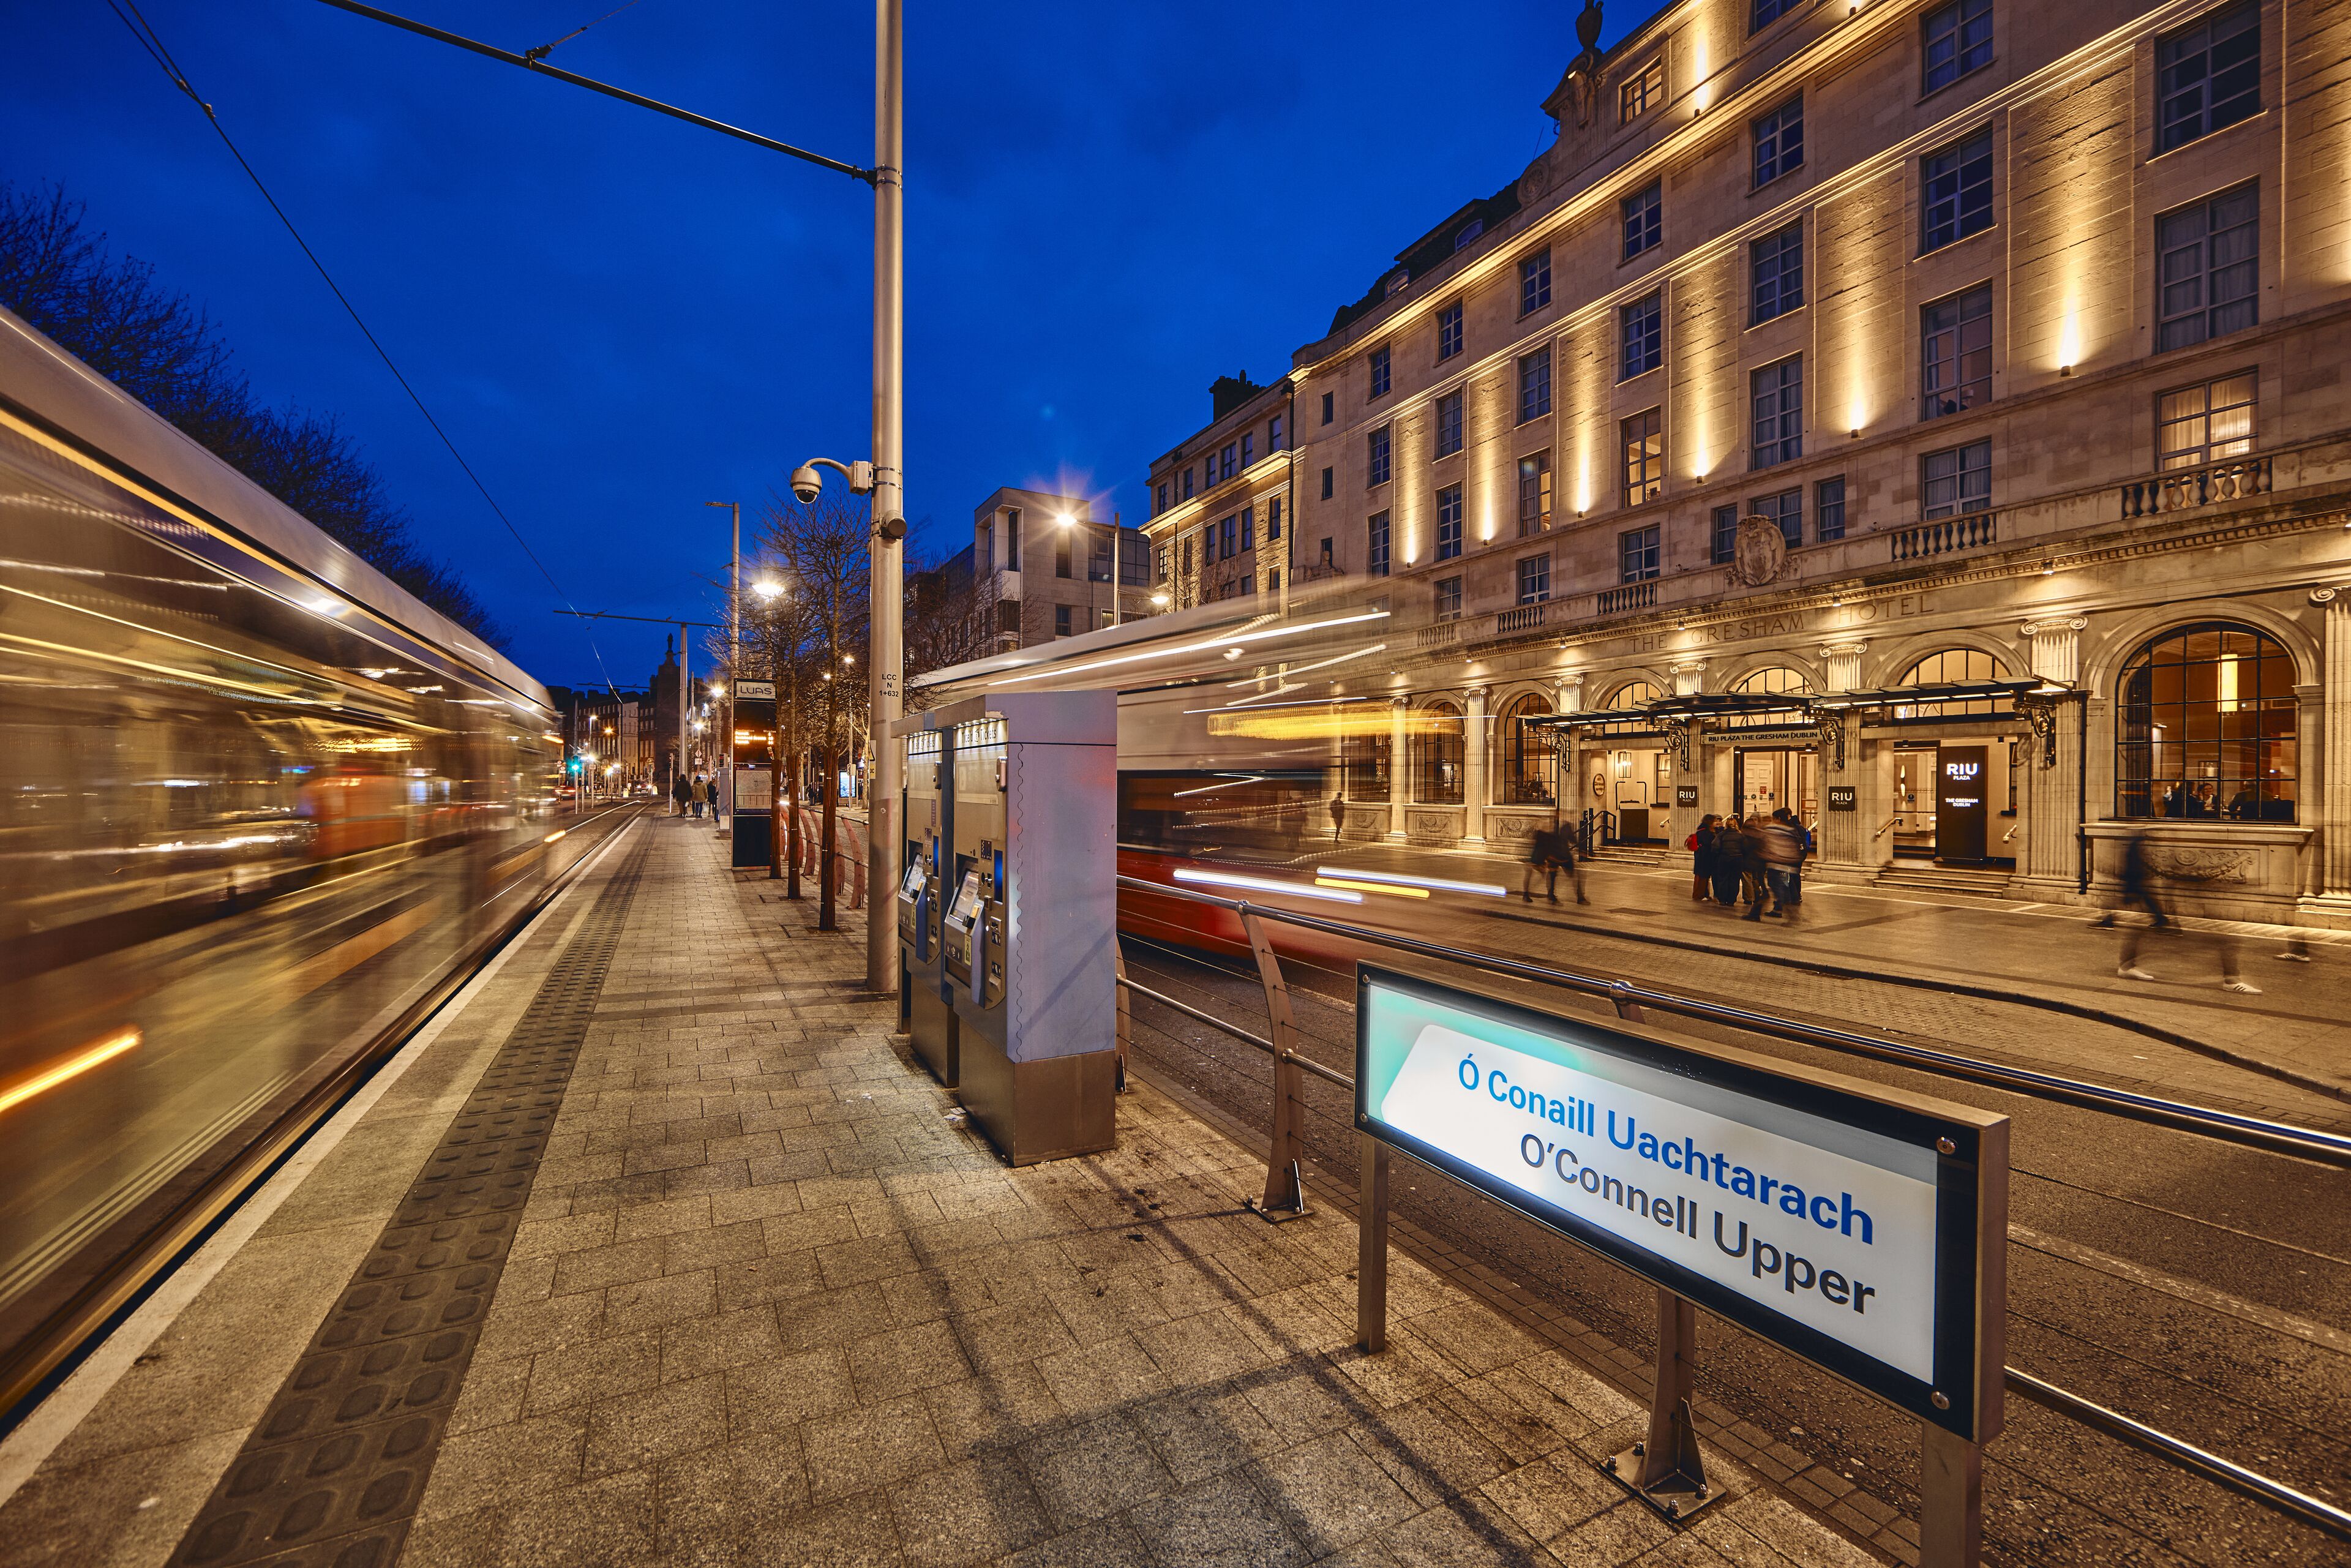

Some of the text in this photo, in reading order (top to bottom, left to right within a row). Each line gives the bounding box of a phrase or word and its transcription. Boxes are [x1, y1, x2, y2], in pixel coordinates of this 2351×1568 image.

[1630, 596, 1934, 653] THE GRESHAM HOTEL
[740, 685, 772, 695] LUAS
[980, 727, 997, 740] Tickets
[1946, 763, 1978, 775] RIU
[1831, 792, 1853, 801] RIU
[1458, 1052, 1873, 1245] Ó Conaill Uachtarach
[1520, 1133, 1876, 1315] O'Connell Upper
